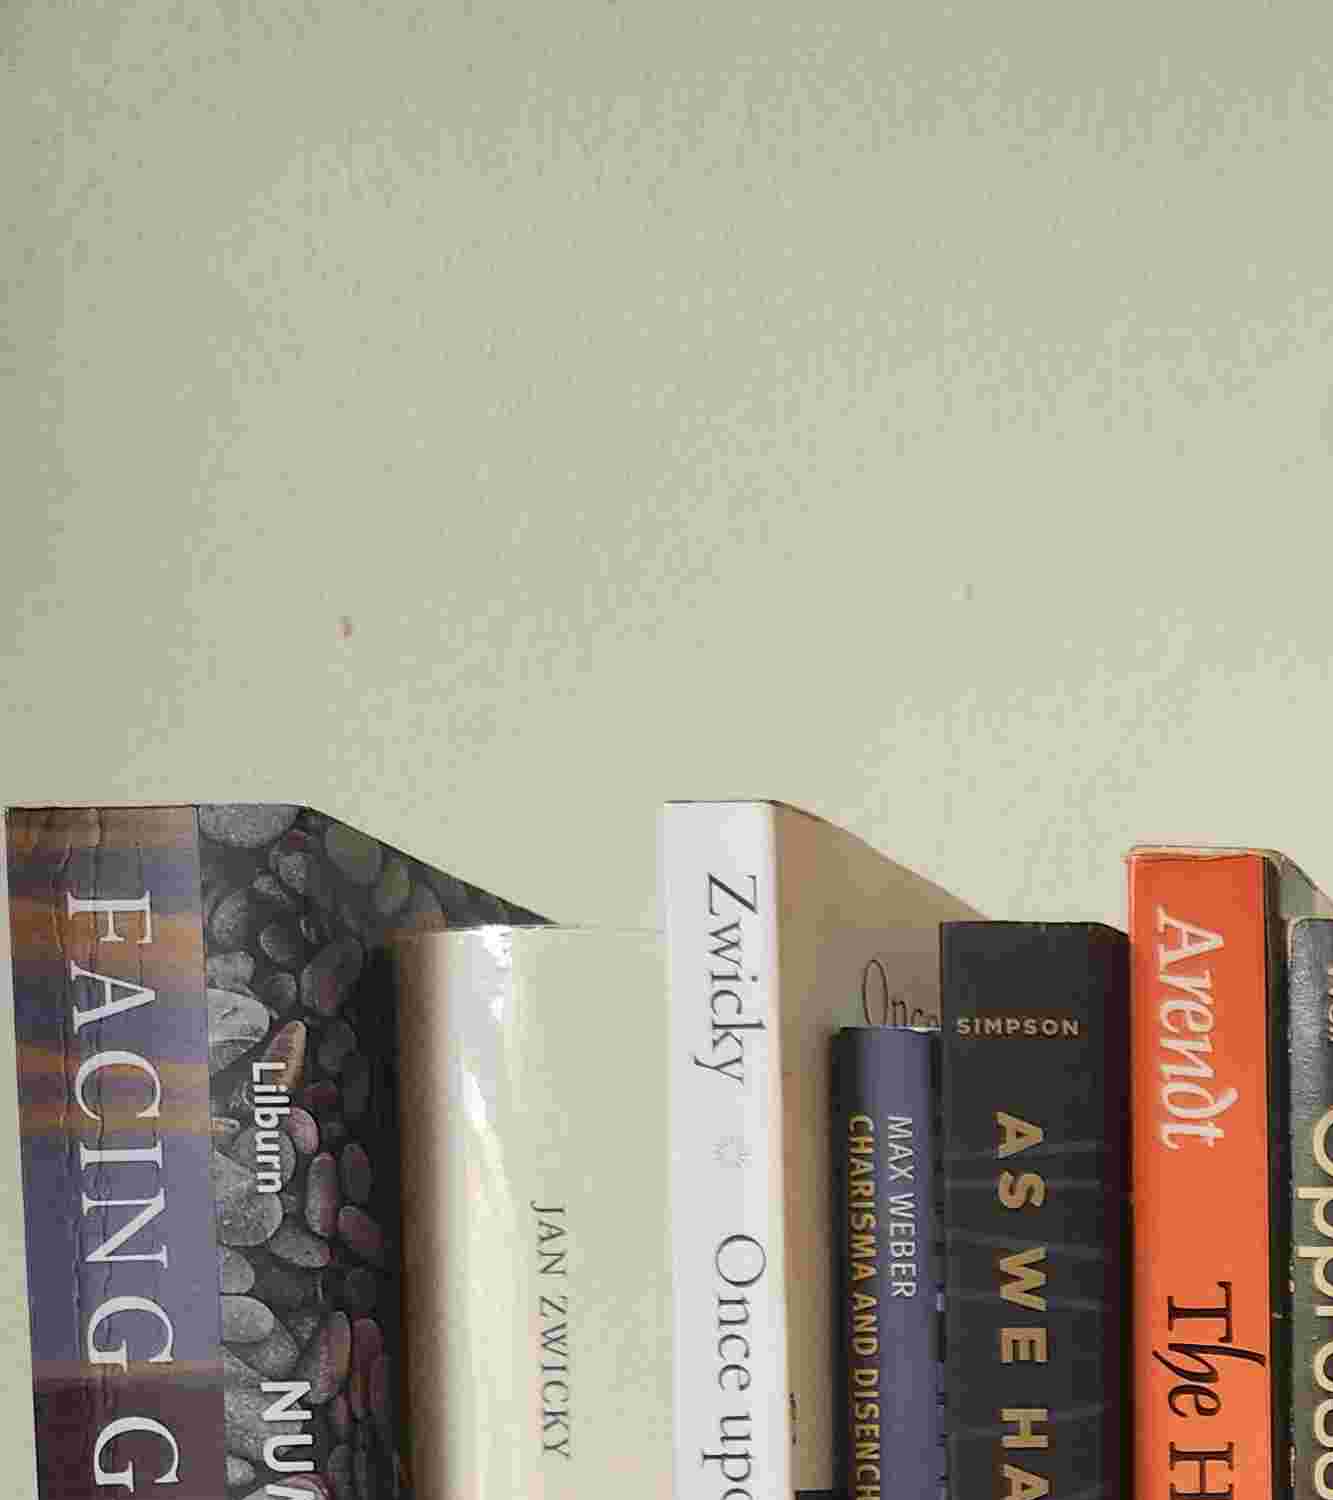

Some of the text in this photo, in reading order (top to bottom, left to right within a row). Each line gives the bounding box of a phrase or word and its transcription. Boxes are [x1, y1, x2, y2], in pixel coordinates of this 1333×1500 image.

[693, 871, 766, 1084] Zwicky
[957, 1017, 1080, 1037] SIMPSON
[1156, 905, 1241, 1150] Arendt
[65, 891, 175, 1373] FACING
[252, 1061, 289, 1195] Lilburn
[848, 1114, 877, 1281] CHARISMA
[997, 1111, 1046, 1210] AS
[888, 1116, 916, 1299] MAX WEBER
[530, 1203, 573, 1461] JAN ZWICKY
[715, 1234, 767, 1392] Once
[854, 1293, 878, 1355] AND
[997, 1245, 1048, 1362] WE
[1153, 1280, 1265, 1419] The
